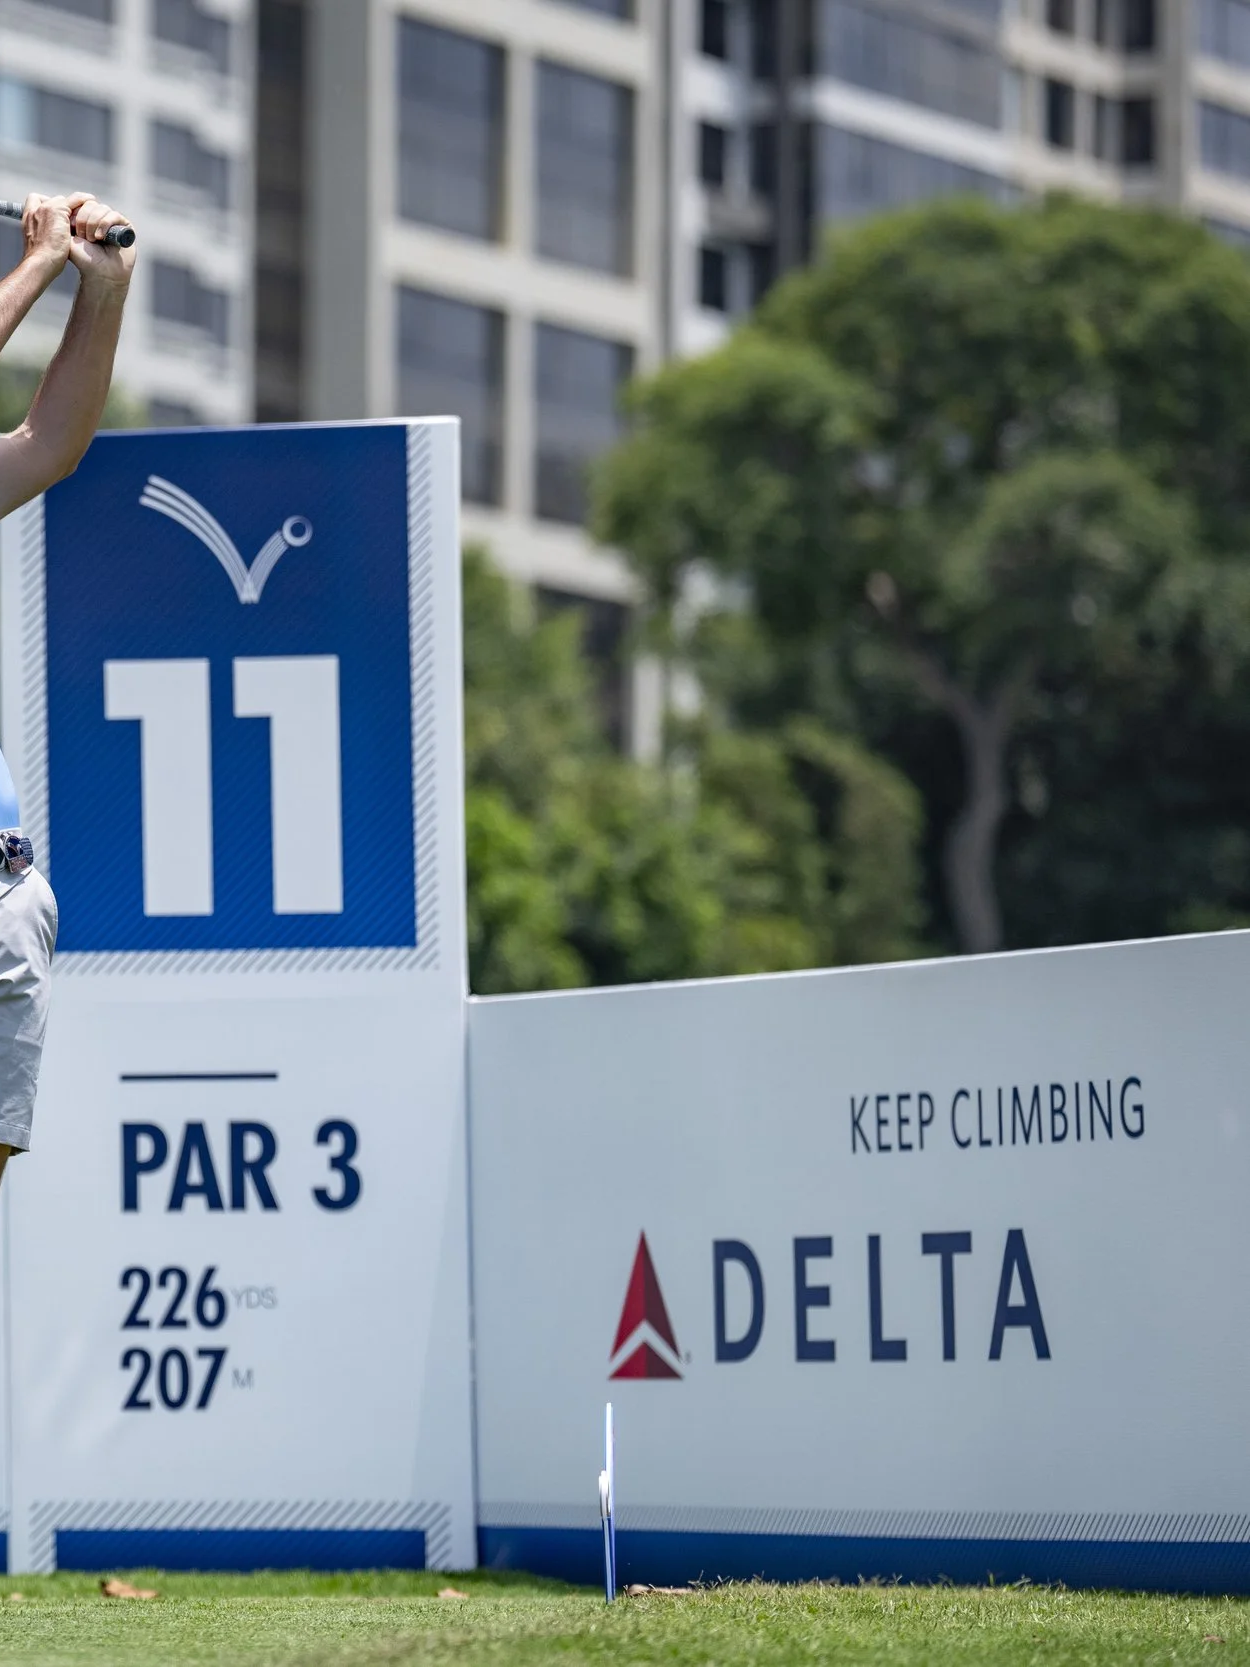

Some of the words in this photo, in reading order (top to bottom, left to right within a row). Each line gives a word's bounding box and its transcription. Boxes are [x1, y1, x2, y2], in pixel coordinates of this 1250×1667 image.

[104, 655, 343, 917] 11
[850, 1092, 935, 1154] KEEP
[950, 1076, 1145, 1150] CLIMBING
[120, 1120, 280, 1213] PAR
[312, 1118, 363, 1213] 3
[119, 1266, 228, 1331] 226
[231, 1285, 278, 1309] YDS
[712, 1228, 1053, 1363] DELTA
[120, 1346, 229, 1412] 207
[232, 1367, 254, 1389] M
